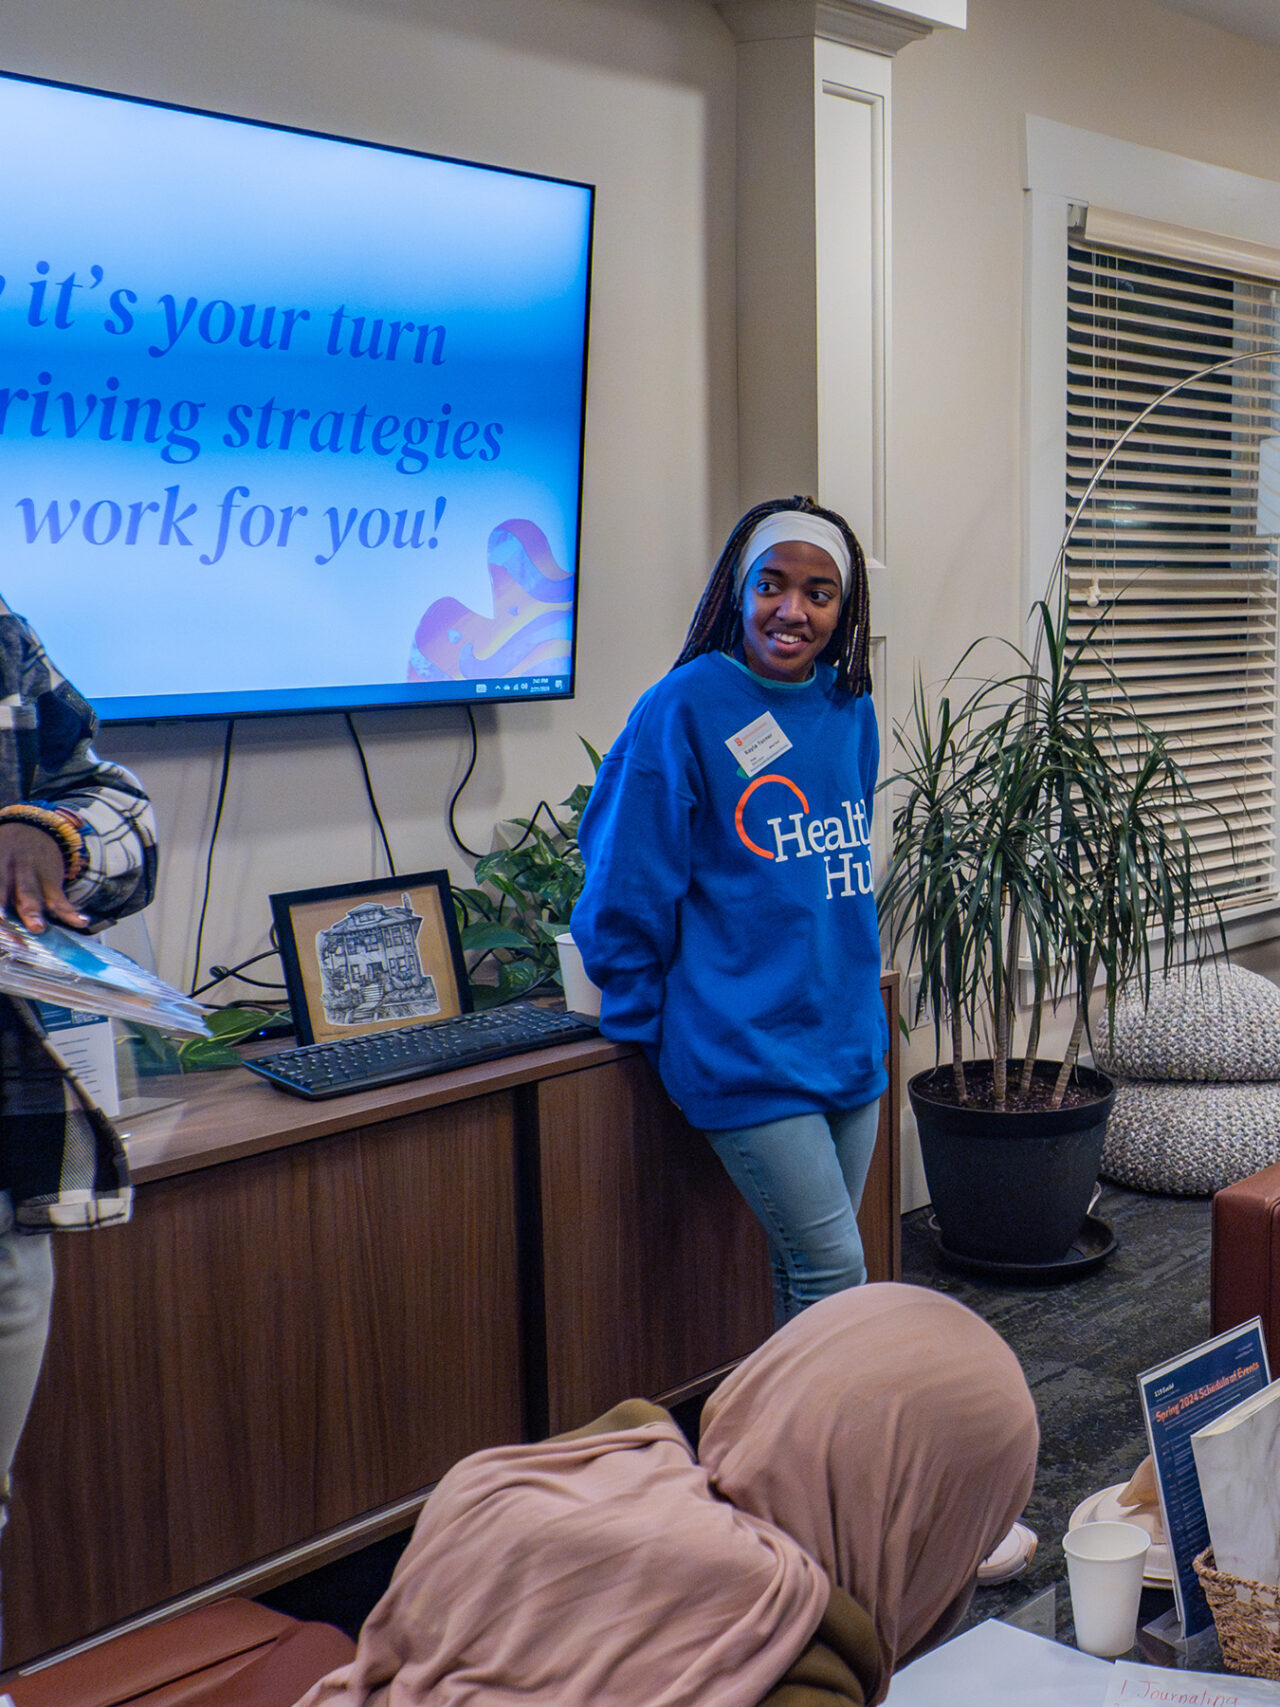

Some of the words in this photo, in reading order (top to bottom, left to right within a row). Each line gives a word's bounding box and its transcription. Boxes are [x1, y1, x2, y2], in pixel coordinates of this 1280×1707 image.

[27, 260, 138, 336] it’s
[148, 293, 311, 359] your
[326, 303, 448, 367] turn
[221, 395, 505, 475] strategies
[15, 483, 198, 548] work
[199, 485, 309, 567] for
[313, 494, 448, 567] you!
[767, 798, 871, 863] Healt
[823, 851, 874, 900] Hu
[1155, 1402, 1180, 1423] Spring
[1179, 1393, 1199, 1410] 2024
[1199, 1376, 1230, 1400] Schedule
[1236, 1361, 1260, 1379] Events
